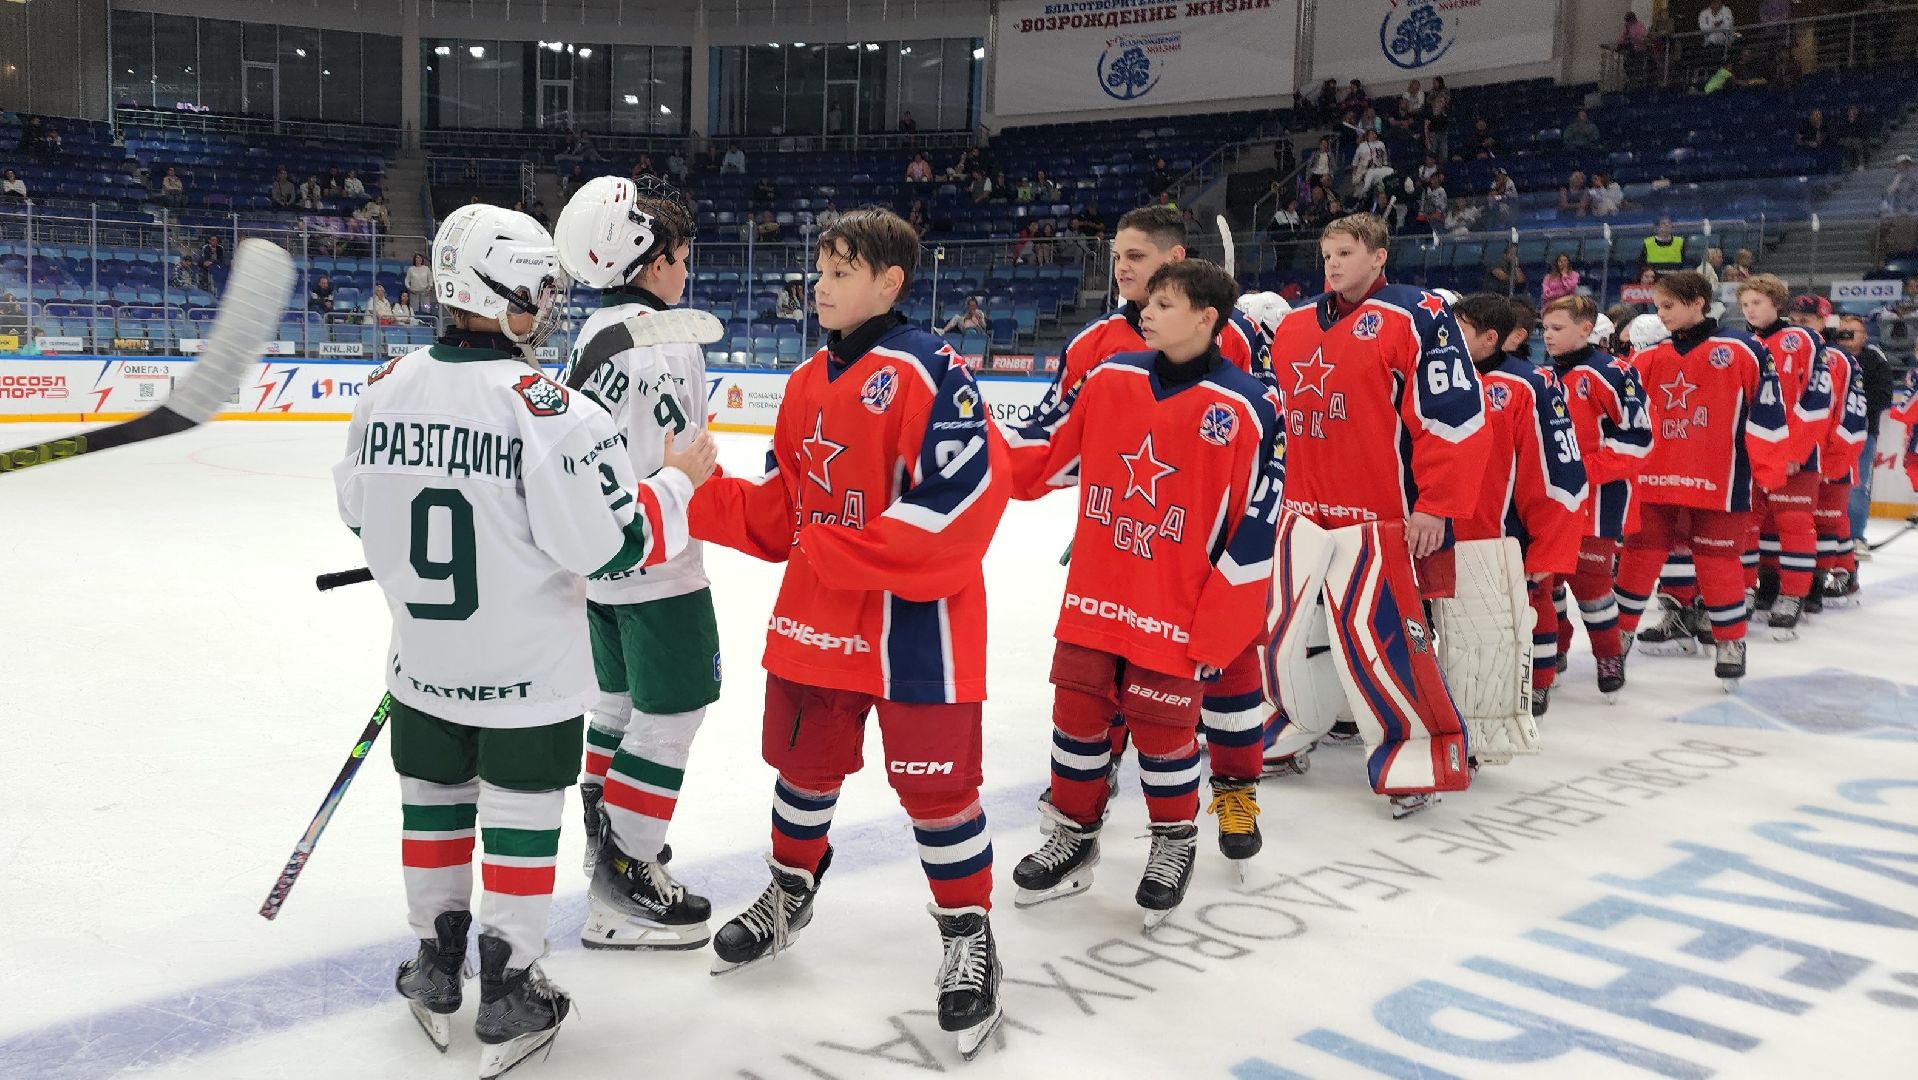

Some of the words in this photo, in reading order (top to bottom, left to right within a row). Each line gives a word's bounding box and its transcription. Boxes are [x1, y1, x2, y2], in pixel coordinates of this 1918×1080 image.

[445, 281, 455, 298] 9
[323, 344, 360, 354] KHL.RU
[993, 357, 1032, 369] FONBET
[1427, 357, 1472, 395] 64
[748, 401, 779, 409] ГУБЕРНА
[1283, 390, 1348, 440] СКА
[1554, 428, 1581, 463] 30
[1085, 483, 1187, 560] ЦСКА
[405, 487, 480, 622] 9
[767, 613, 871, 655] ОСНЕФТЬ
[1064, 593, 1191, 645] РОСНЕФТЬ
[408, 676, 533, 701] TATNEFT
[1127, 684, 1193, 708] BAUER
[1519, 648, 1534, 714] TRUE
[890, 760, 954, 775] CCM
